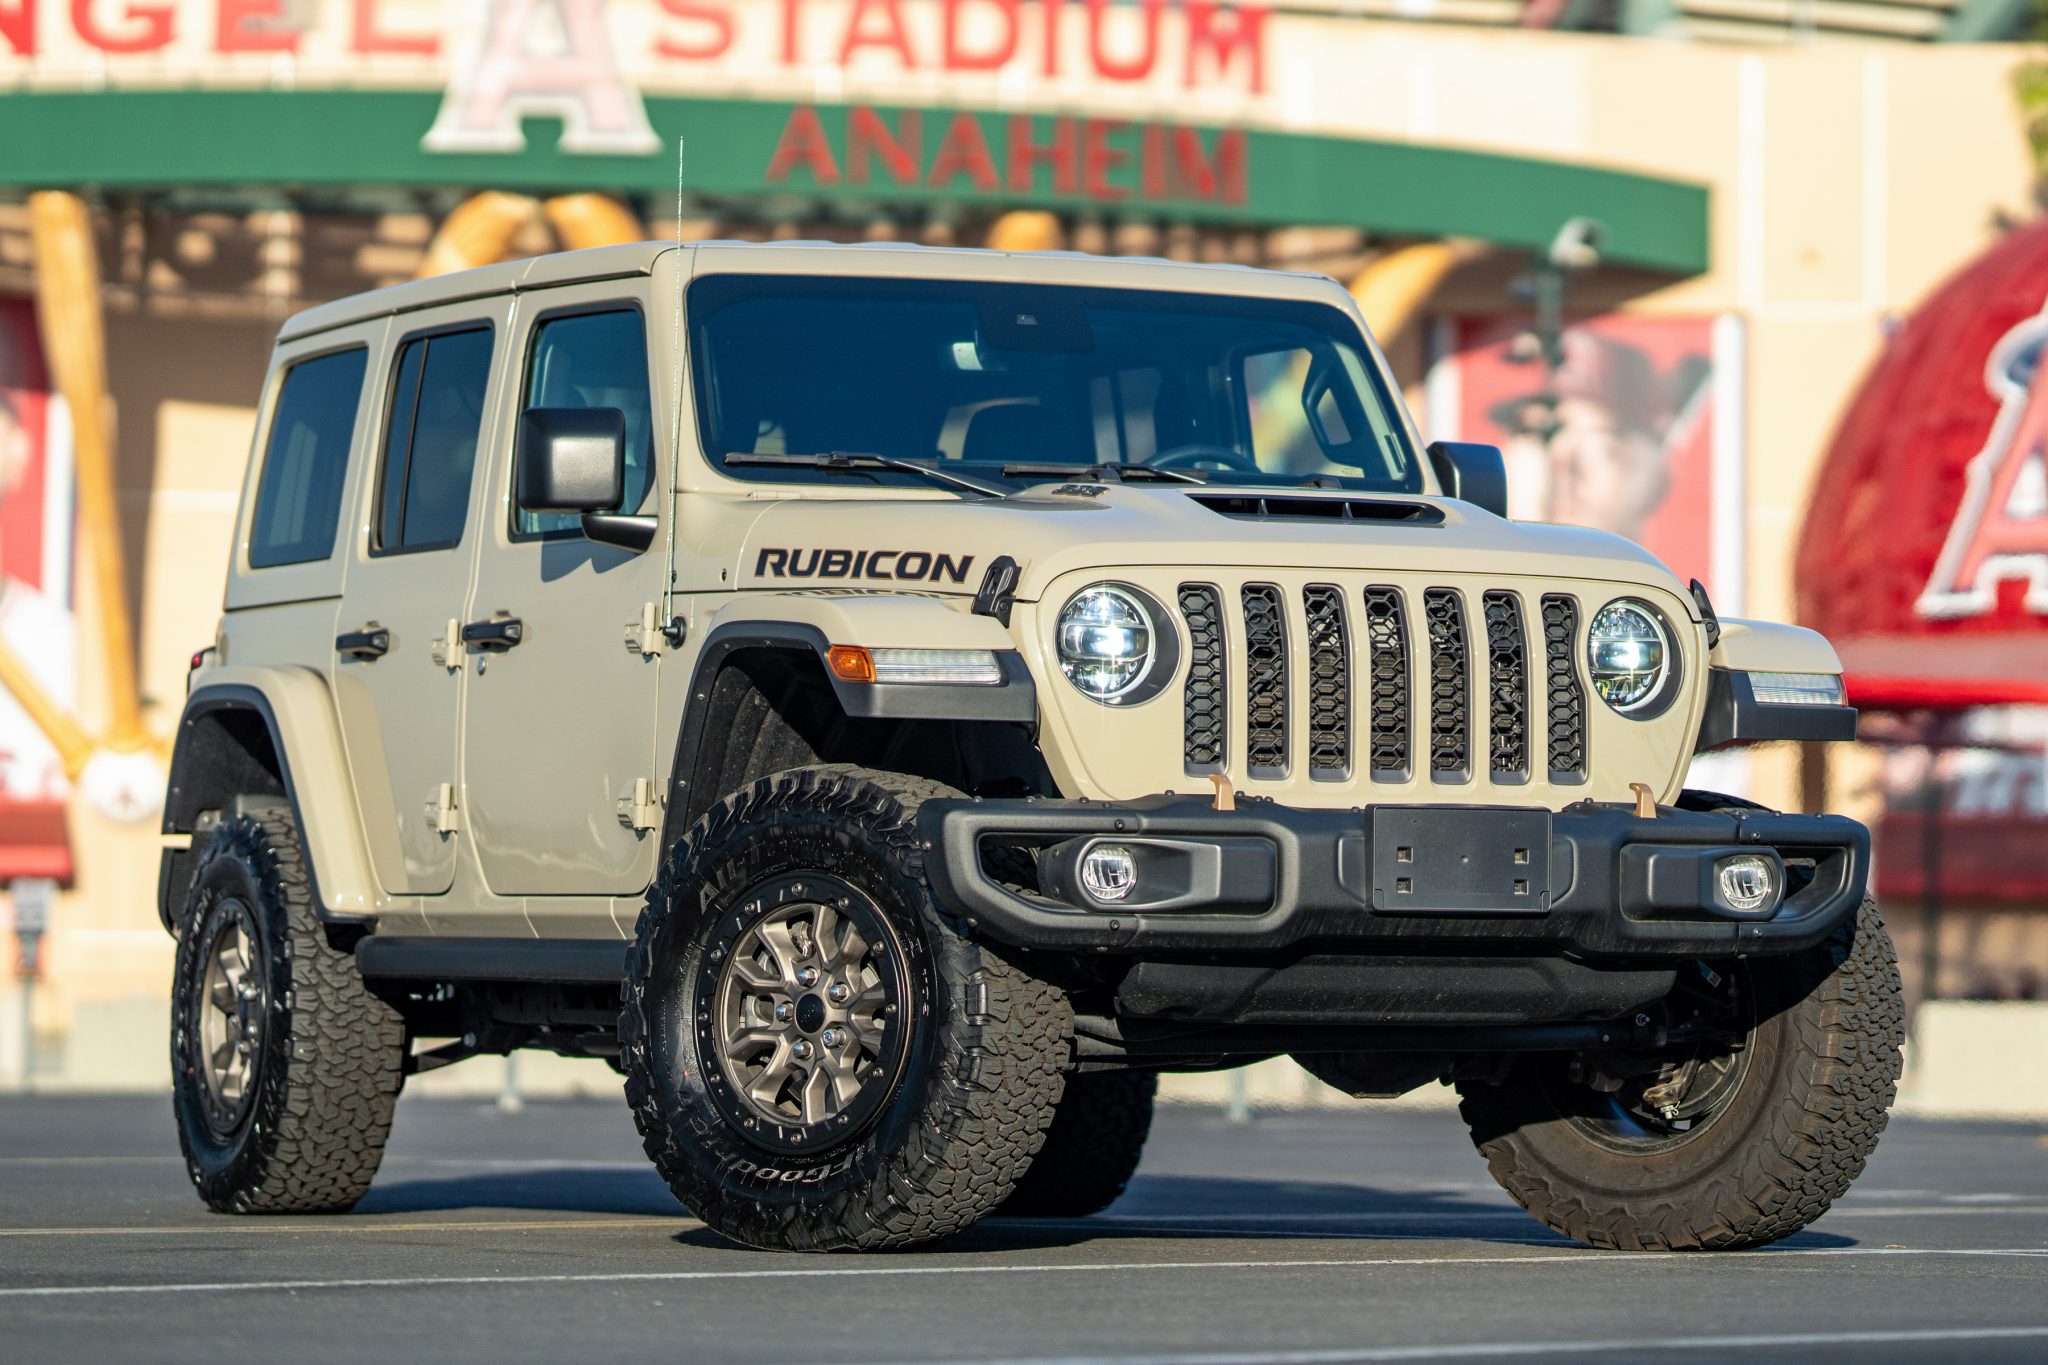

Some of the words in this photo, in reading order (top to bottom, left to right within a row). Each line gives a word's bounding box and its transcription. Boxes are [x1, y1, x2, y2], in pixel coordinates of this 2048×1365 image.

[655, 0, 1268, 94] STADIUM
[764, 103, 1249, 206] ANAHEIM
[754, 546, 977, 585] RUBICON
